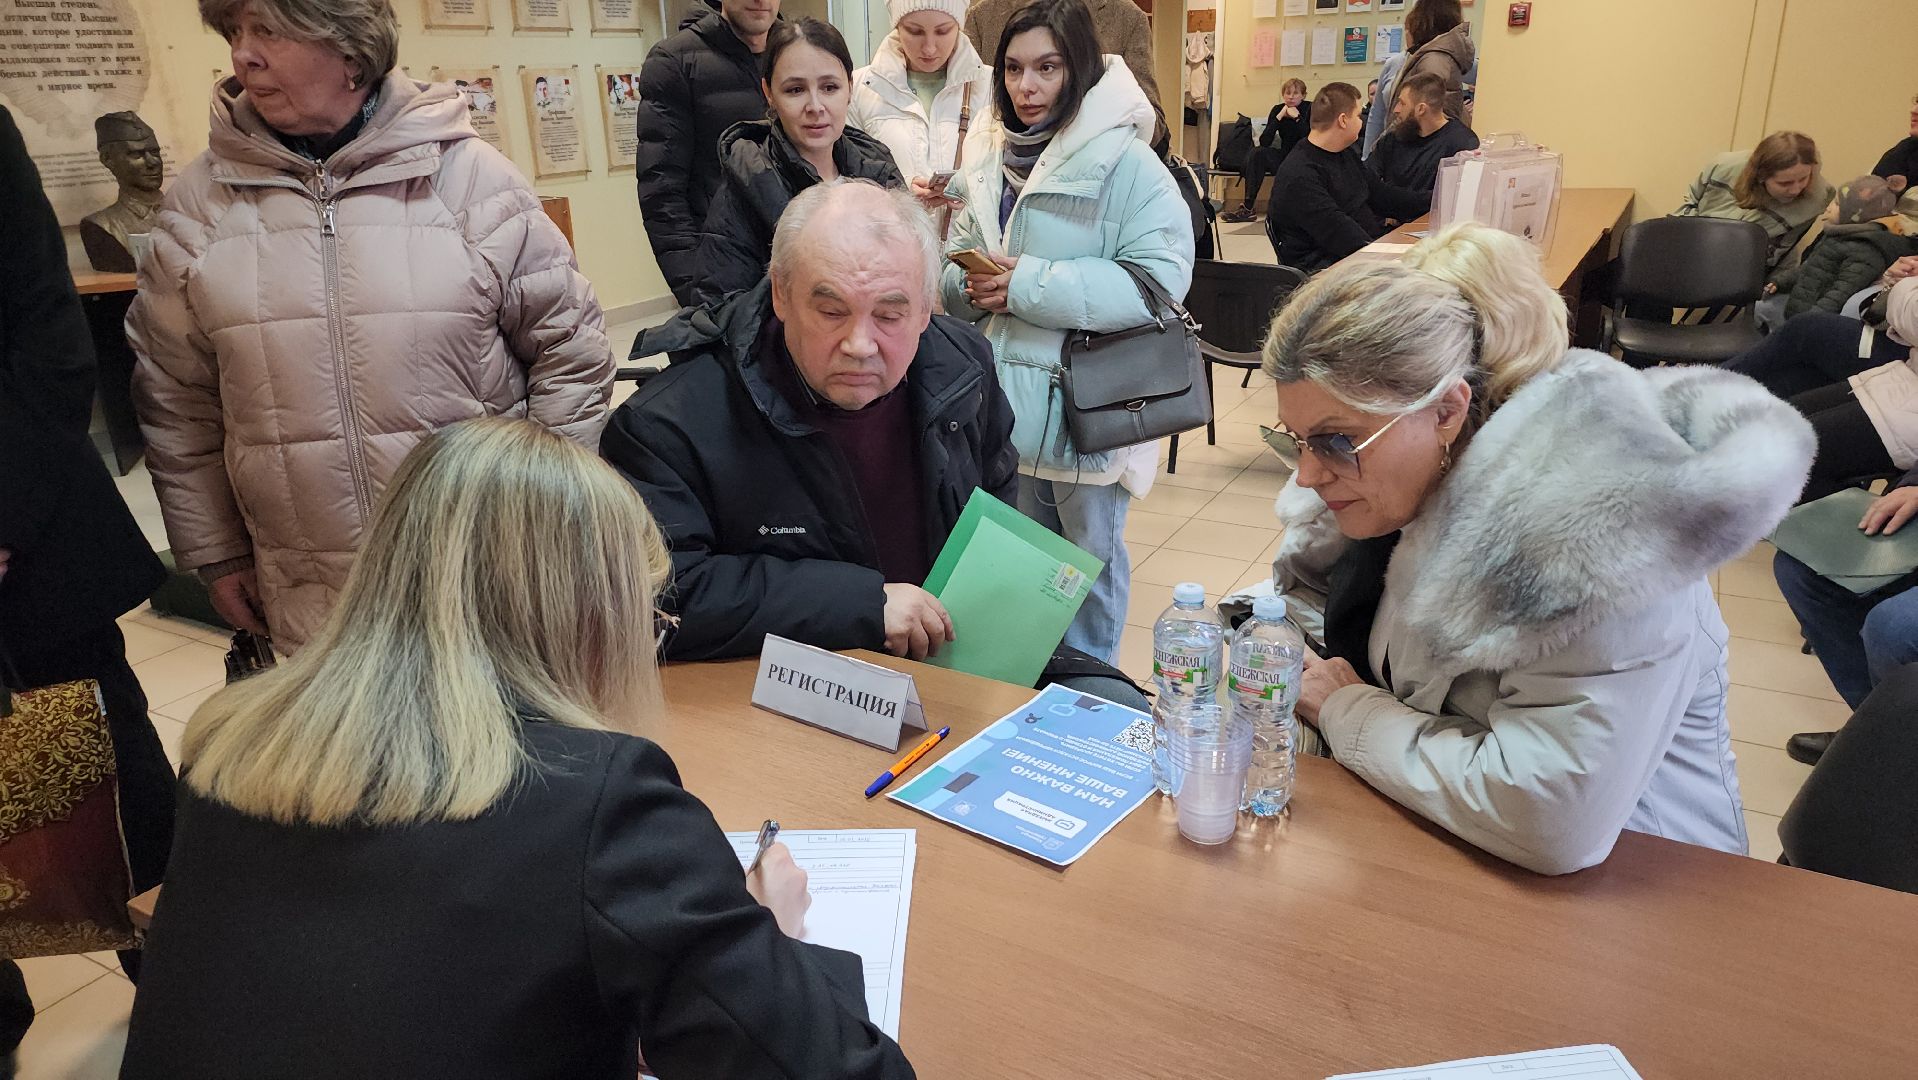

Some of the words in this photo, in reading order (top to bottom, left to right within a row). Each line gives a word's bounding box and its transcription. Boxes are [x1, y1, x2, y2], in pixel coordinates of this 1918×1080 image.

[32, 29, 70, 38] которое
[66, 56, 96, 65] заслуг
[116, 56, 141, 65] время
[48, 83, 82, 93] мирное
[771, 527, 806, 535] Columbia
[767, 663, 897, 719] РЕГИСТРАЦИЯ
[1001, 747, 1076, 779] МНЕНИЕ!
[1010, 765, 1075, 793] ВАЖНО
[1074, 774, 1129, 798] ВАШЕ
[1073, 788, 1116, 809] НАМ
